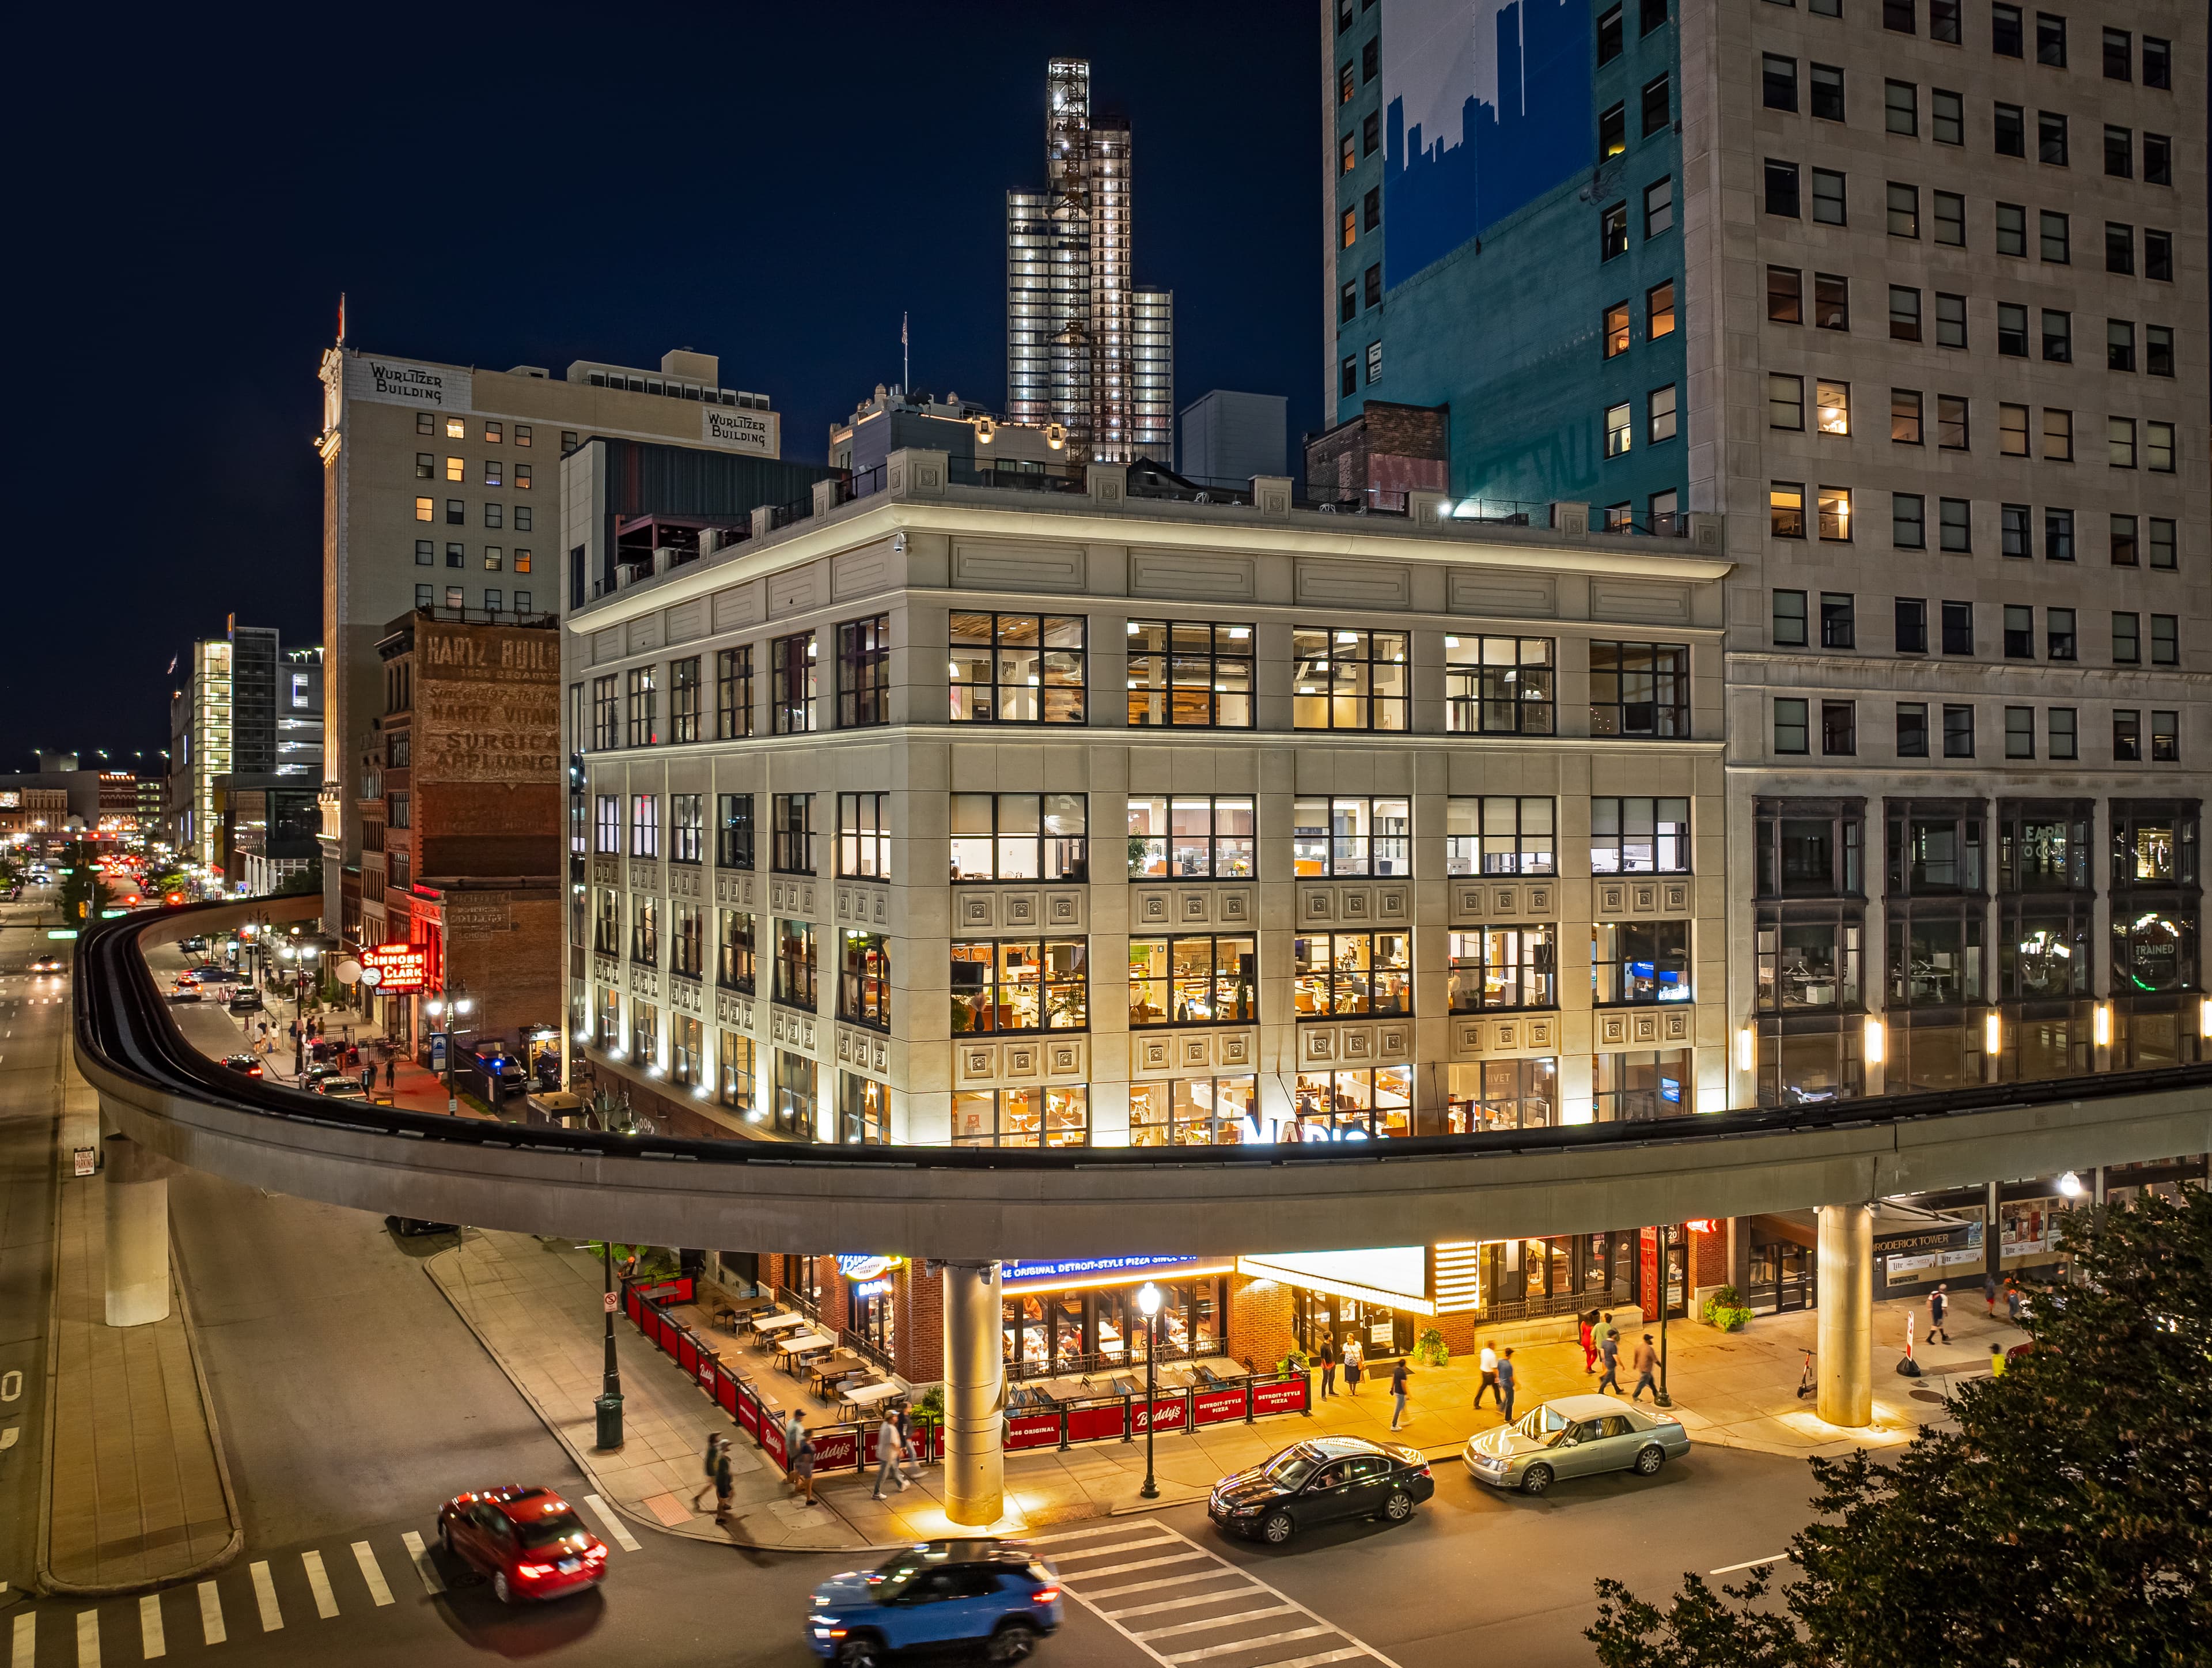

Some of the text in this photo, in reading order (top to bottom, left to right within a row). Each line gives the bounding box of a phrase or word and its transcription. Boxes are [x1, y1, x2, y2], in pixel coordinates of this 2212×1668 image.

[370, 362, 442, 388] WURLITZER
[376, 378, 442, 404] BUILDING
[708, 411, 765, 432] WURLITZER
[712, 425, 765, 447] BUILDING
[428, 636, 487, 667] HARTZ
[432, 703, 490, 722] HARTZ
[2021, 826, 2066, 842] EARN
[2021, 845, 2032, 857] O
[2135, 944, 2175, 955] TRAINED
[363, 952, 423, 966] SIMMONS
[383, 965, 423, 978] CLARK
[381, 978, 422, 986] JEWELERS
[376, 986, 397, 996] BULOVA
[76, 1158, 93, 1169] PARKING
[1919, 1234, 1949, 1246] TOWER
[1941, 1253, 1952, 1264] Lite
[1014, 1266, 1056, 1277] ORIGINAL
[1126, 1256, 1150, 1266] PIZZA
[1893, 1261, 1904, 1271] Lite
[1024, 1426, 1055, 1435] ORIGINAL
[813, 1443, 850, 1462] uddy's
